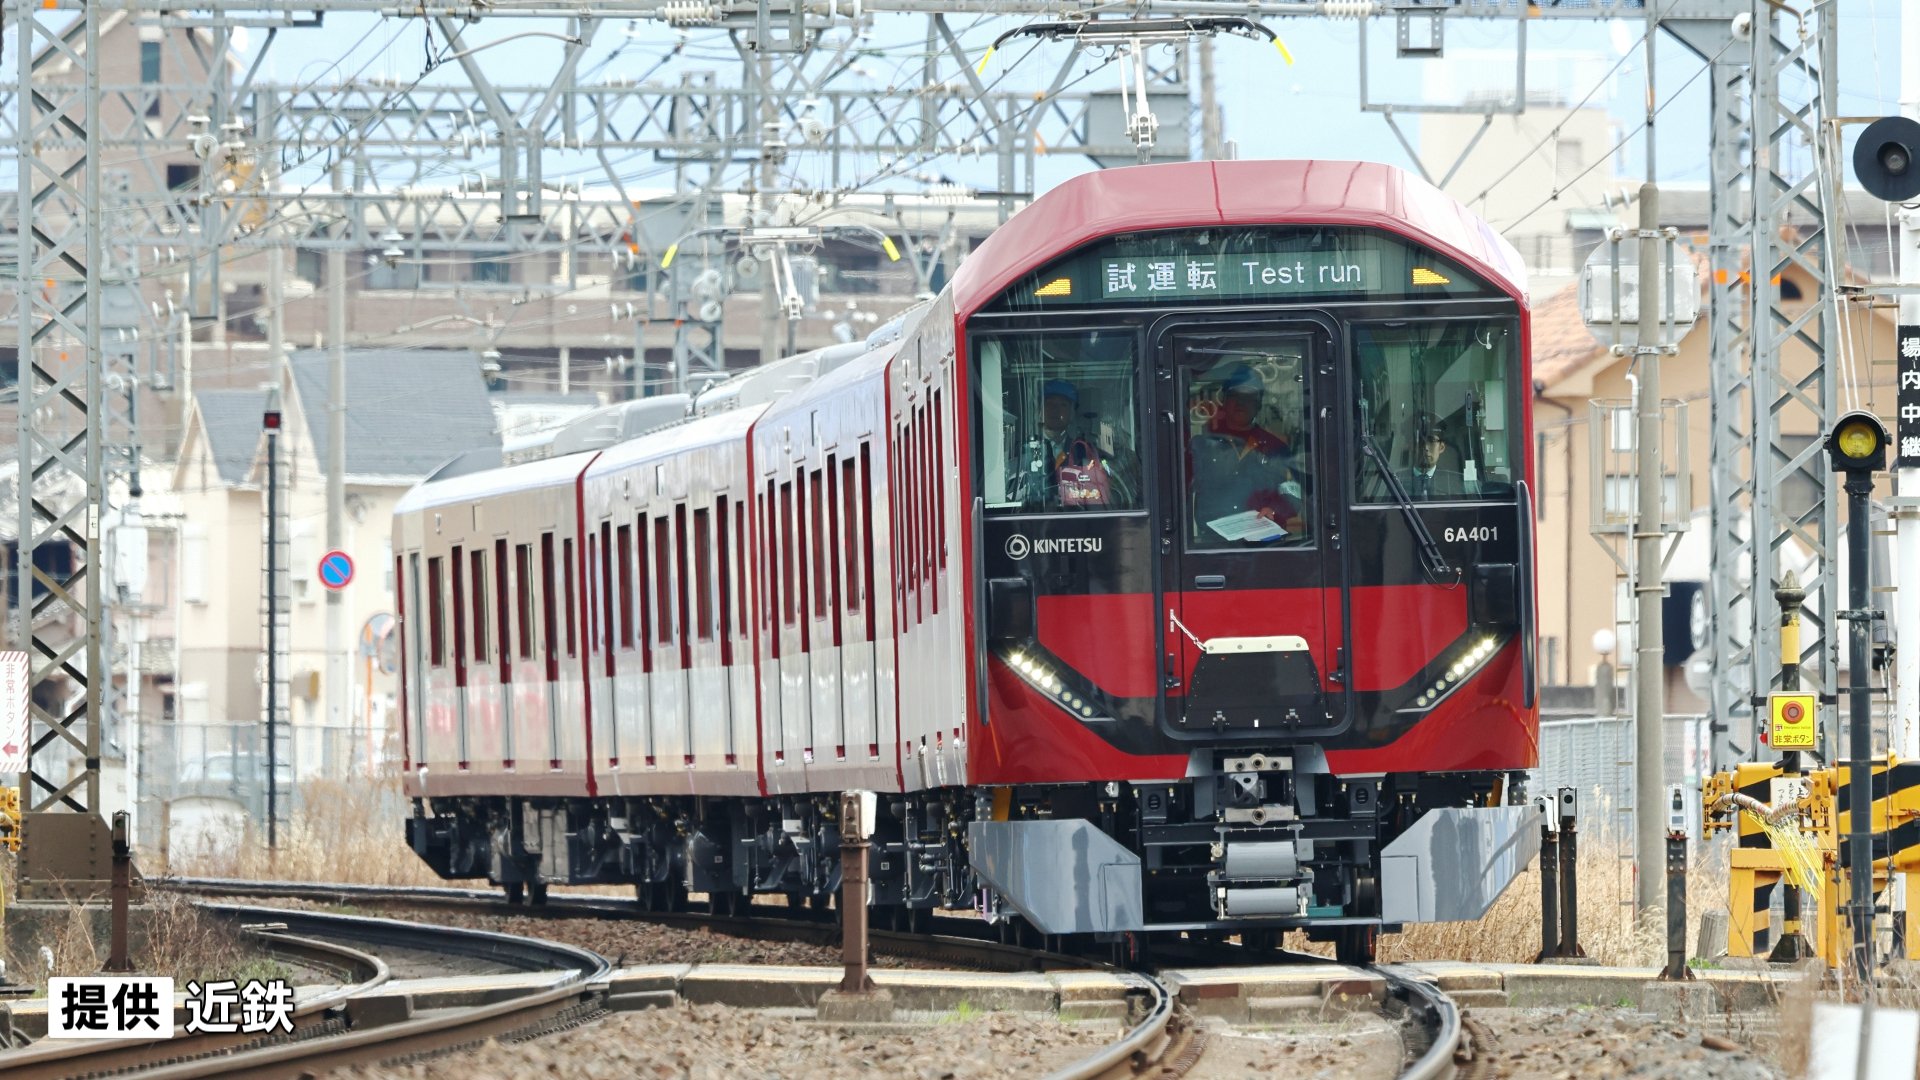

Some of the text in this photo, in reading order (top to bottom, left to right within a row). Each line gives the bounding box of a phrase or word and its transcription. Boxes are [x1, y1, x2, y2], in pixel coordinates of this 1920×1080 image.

[1107, 262, 1361, 292] 試運転 Test run
[1444, 526, 1498, 543] 6A401
[1034, 537, 1102, 554] KINTETSU
[1774, 734, 1813, 744] 非常ボタン
